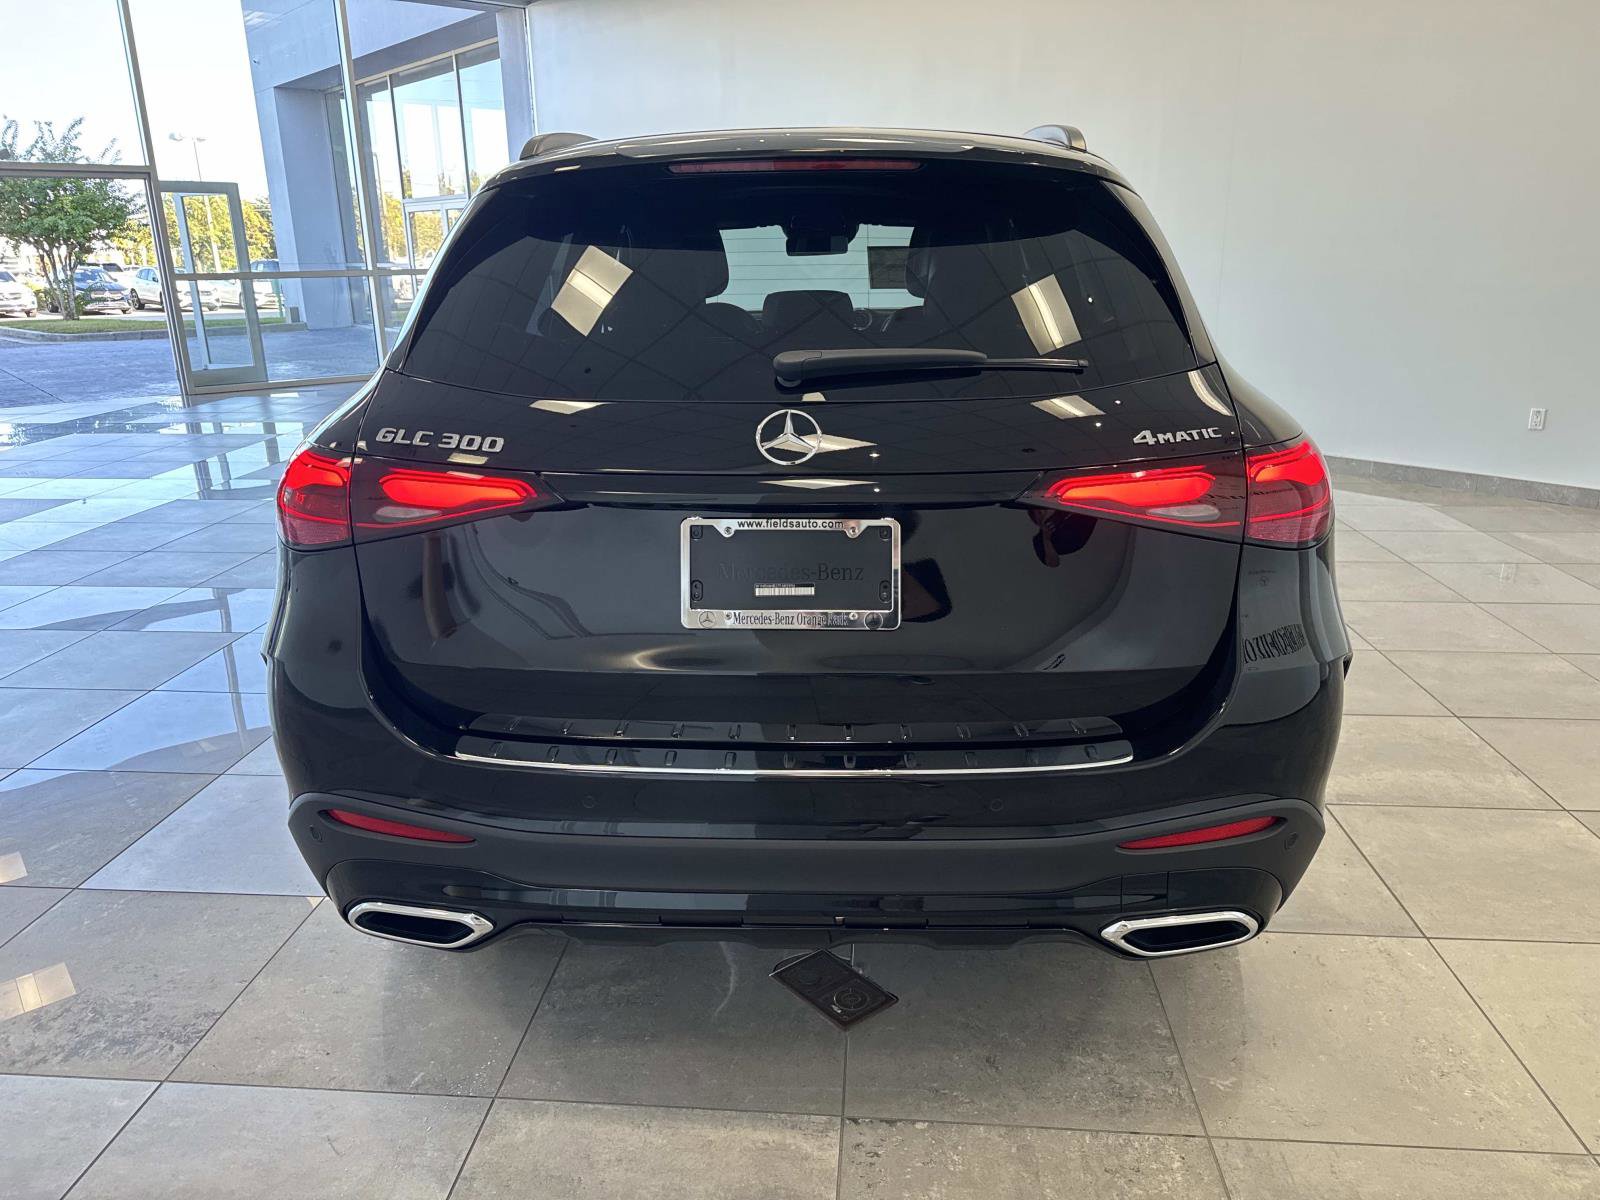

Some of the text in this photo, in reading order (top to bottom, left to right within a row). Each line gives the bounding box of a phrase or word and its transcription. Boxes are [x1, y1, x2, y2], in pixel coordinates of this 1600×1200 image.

[375, 427, 505, 453] GLC 300
[1133, 427, 1222, 445] 4MATIC
[737, 519, 844, 529] www.fieldsauto.com
[732, 612, 795, 626] Mercedes-Benz
[797, 612, 827, 626] Orange
